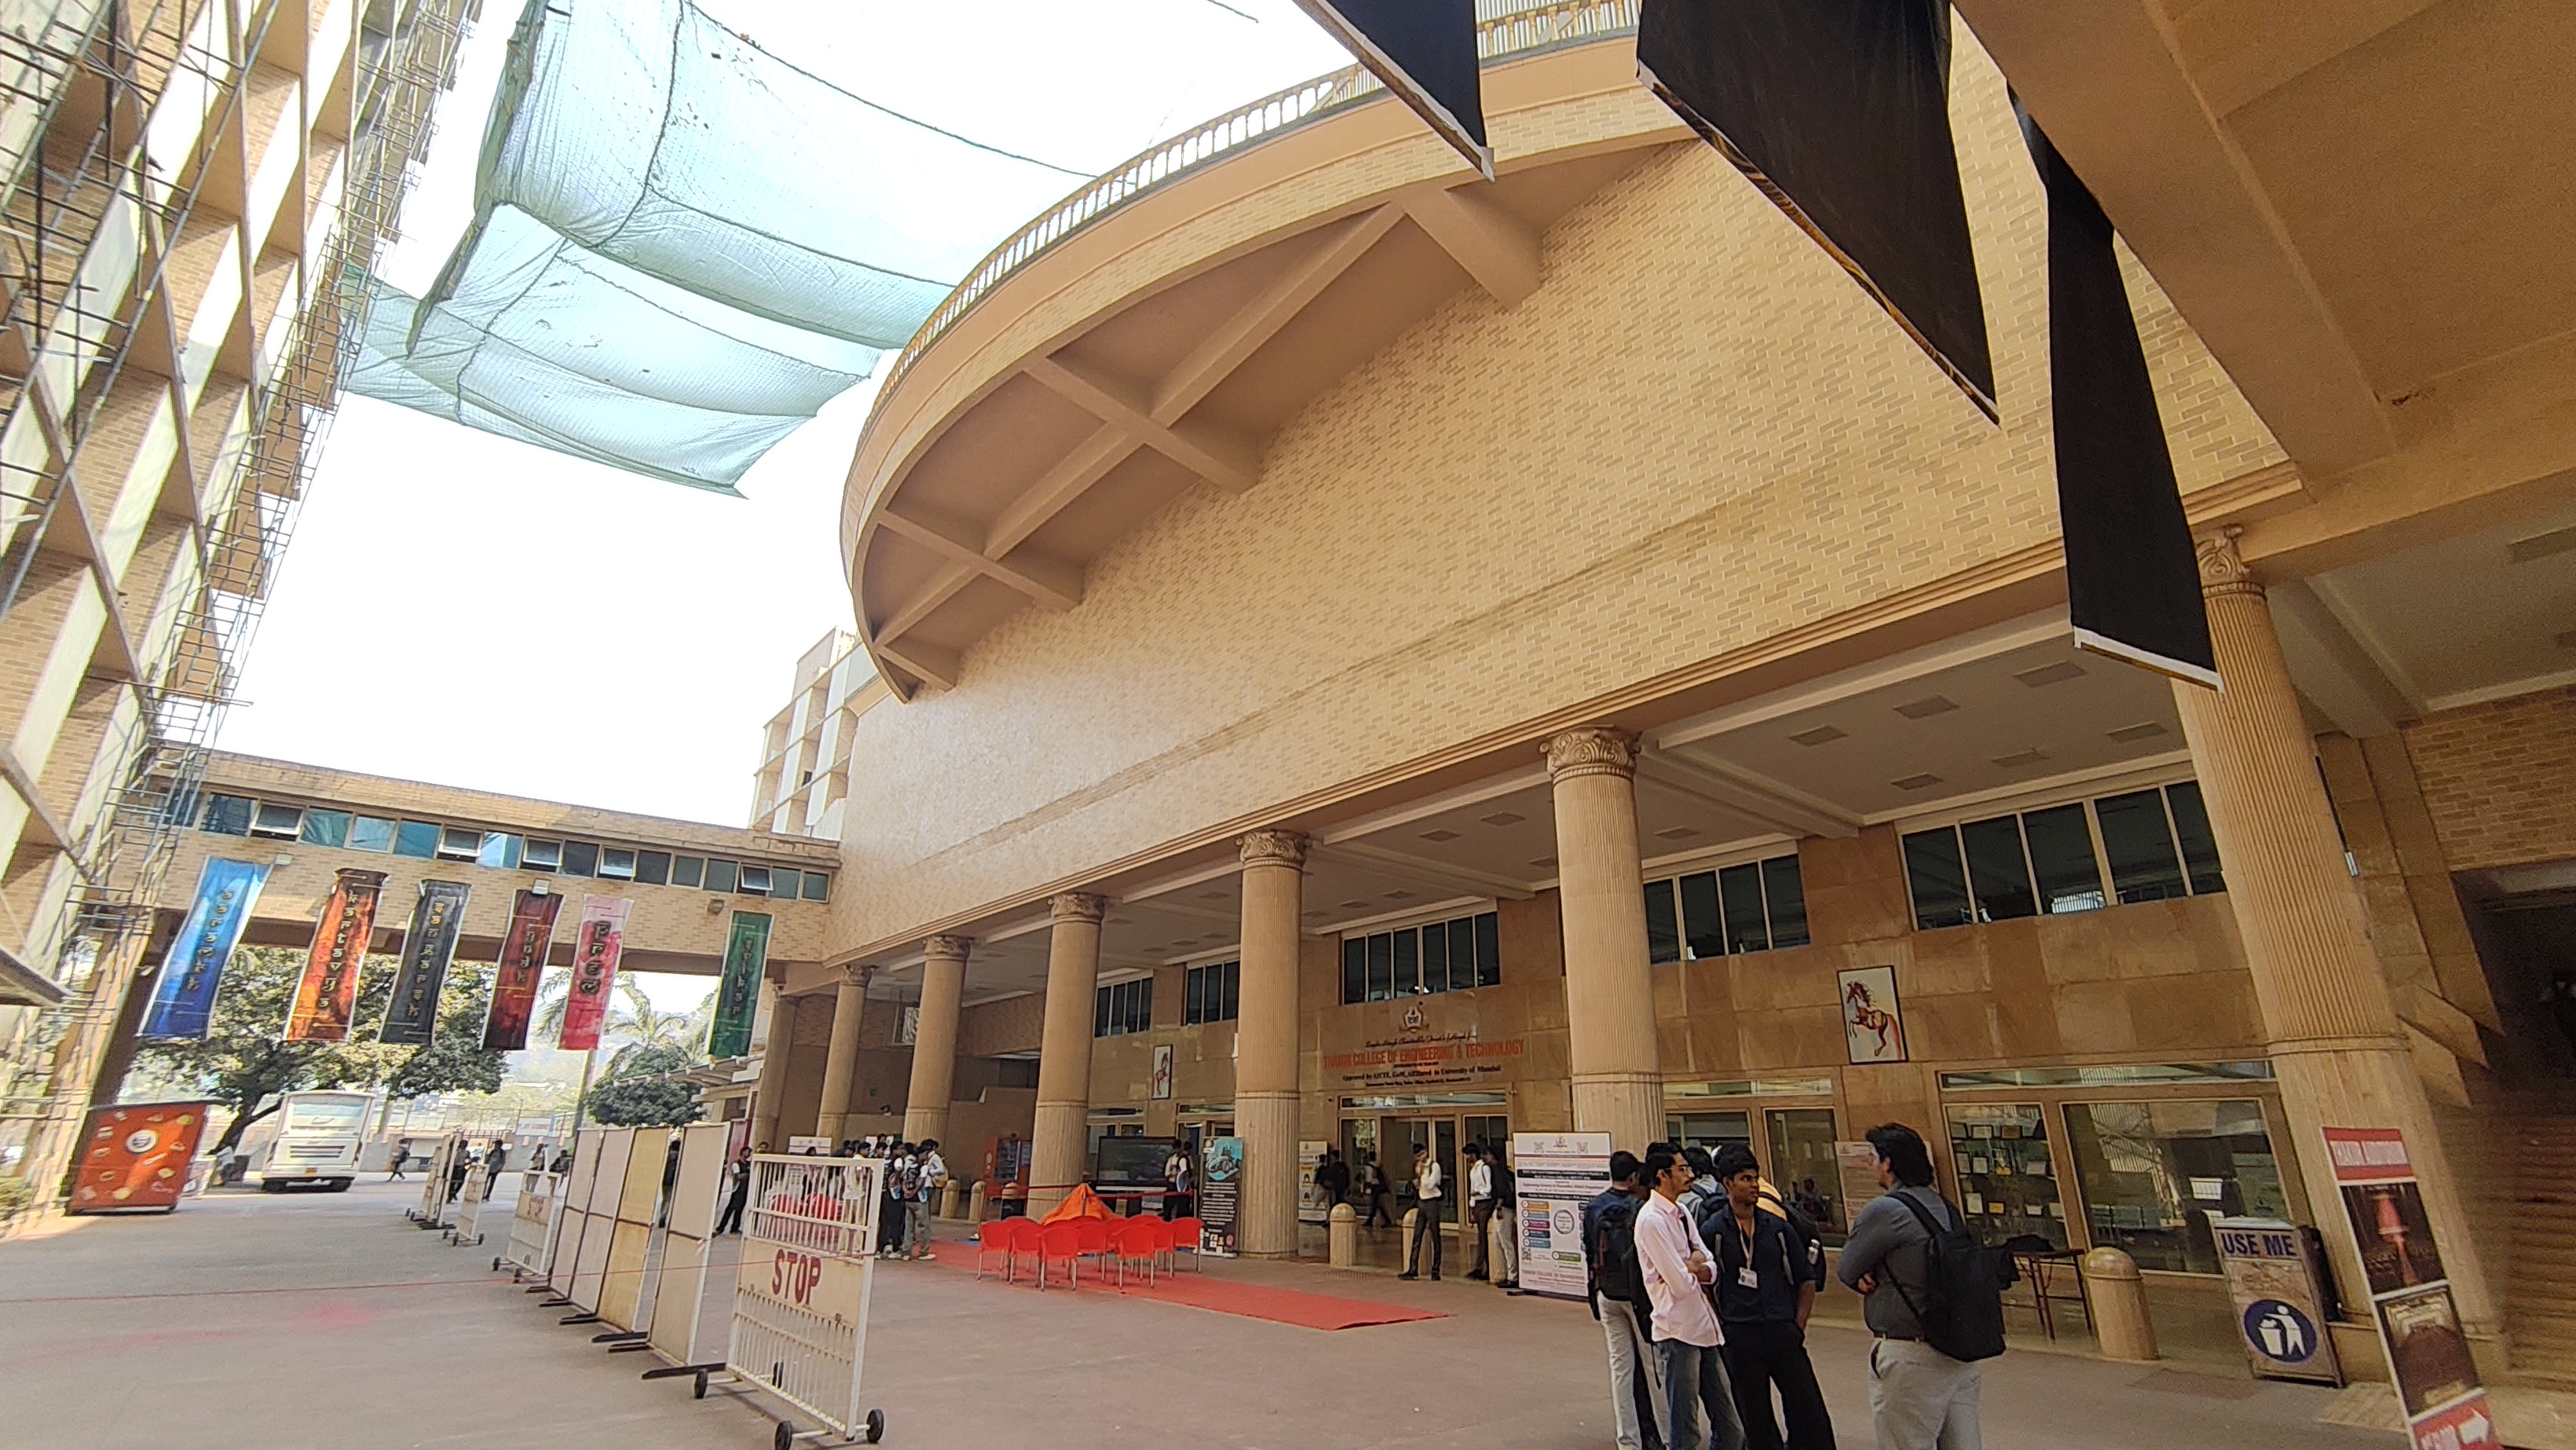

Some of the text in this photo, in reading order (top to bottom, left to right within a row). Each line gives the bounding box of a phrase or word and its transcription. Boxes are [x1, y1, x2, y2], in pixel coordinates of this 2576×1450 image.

[1353, 1050, 1386, 1067] COLLEGE
[1387, 1049, 1397, 1064] OF
[1465, 1038, 1524, 1059] TECHNOLOGY
[2221, 1232, 2298, 1257] USE ME
[771, 1247, 821, 1305] STOP
